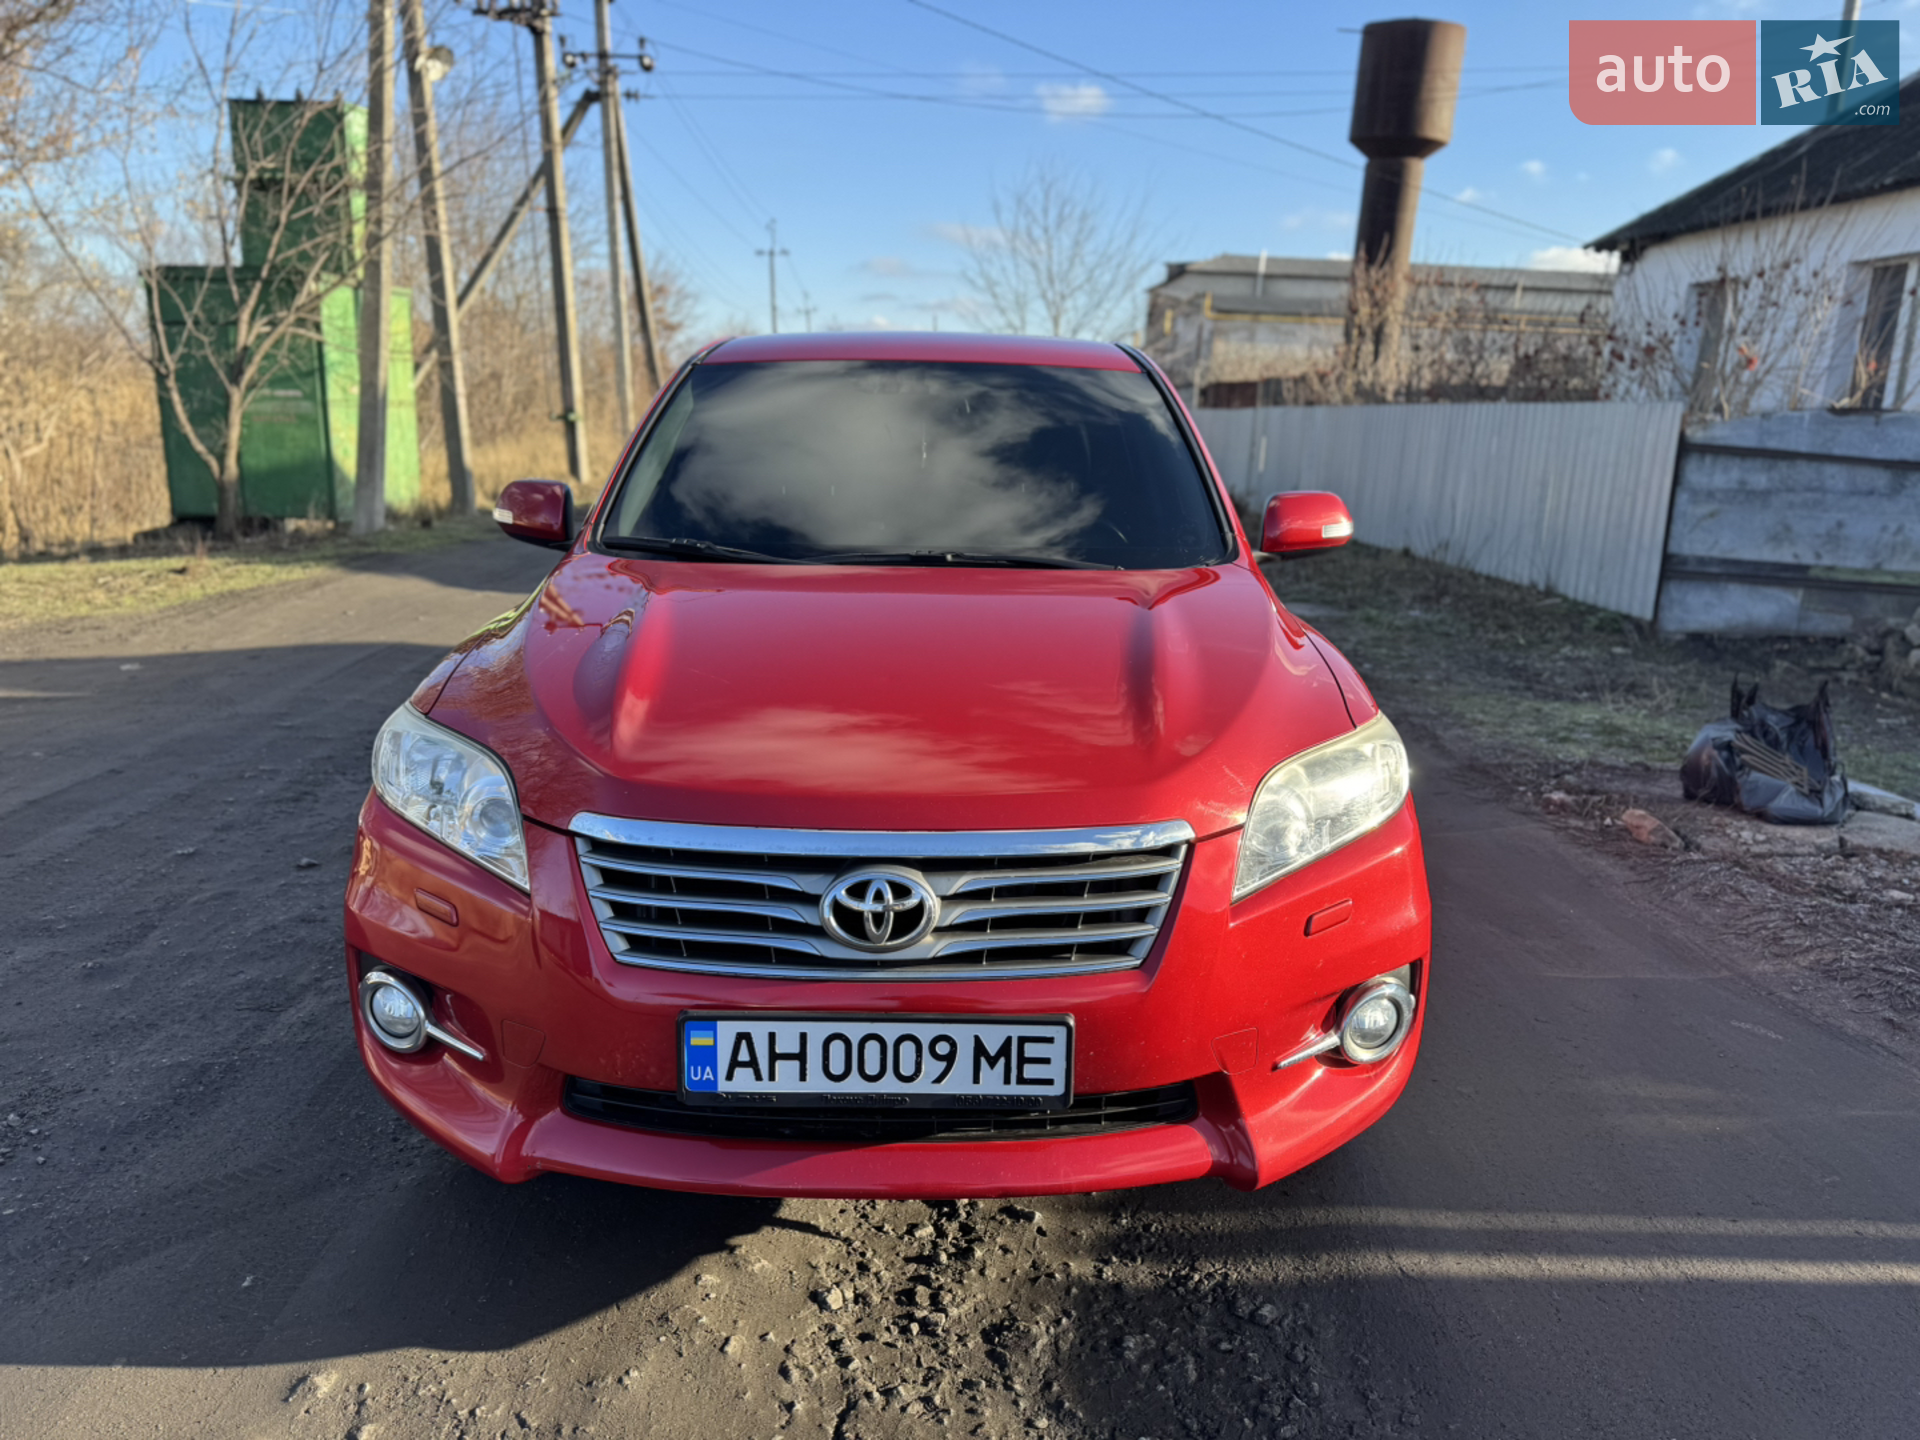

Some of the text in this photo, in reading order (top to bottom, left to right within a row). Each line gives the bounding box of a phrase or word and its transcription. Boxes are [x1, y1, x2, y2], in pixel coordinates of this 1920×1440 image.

[690, 1065, 714, 1081] UA
[725, 1031, 1055, 1086] AH 0009 ME
